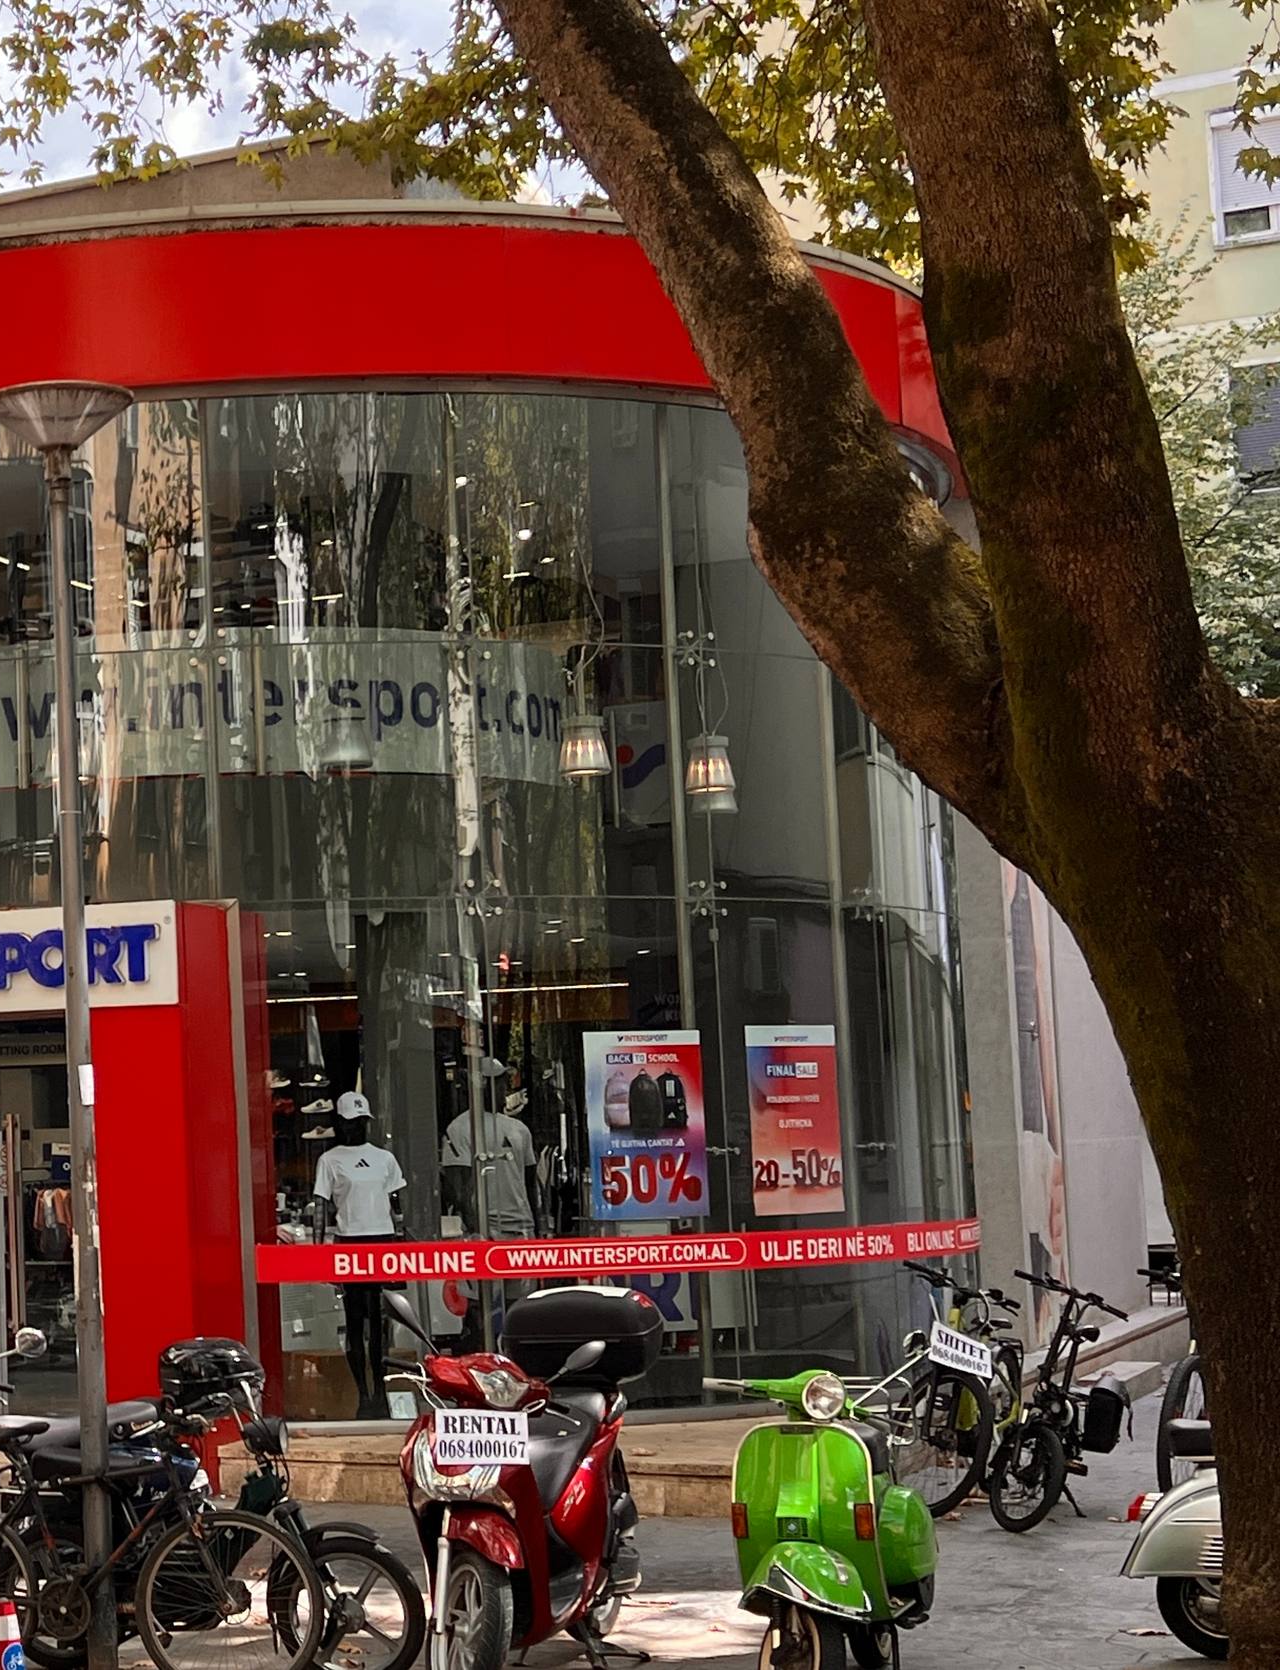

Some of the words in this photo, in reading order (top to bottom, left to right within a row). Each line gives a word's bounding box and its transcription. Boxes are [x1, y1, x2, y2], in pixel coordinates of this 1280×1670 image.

[608, 1054, 632, 1063] BACK
[634, 1054, 645, 1063] TO
[648, 1053, 679, 1063] SCHOOL
[766, 1064, 795, 1077] FINAL
[797, 1064, 817, 1076] SALE
[600, 1152, 702, 1206] 50%
[334, 1251, 375, 1276] BLI
[382, 1250, 475, 1275] ONLINE
[506, 1244, 731, 1268] WWW.INTERSPORT.COM.AL
[760, 1239, 803, 1262] ULJE
[807, 1237, 843, 1260] DERI
[846, 1231, 865, 1258] NË
[868, 1234, 894, 1256] 50%
[907, 1232, 925, 1252] BLI
[926, 1229, 955, 1251] ONLINE
[937, 1329, 988, 1360] SHITET
[931, 1344, 989, 1374] 0684000167
[443, 1415, 521, 1436] RENTAL
[439, 1439, 526, 1459] 0684000167
